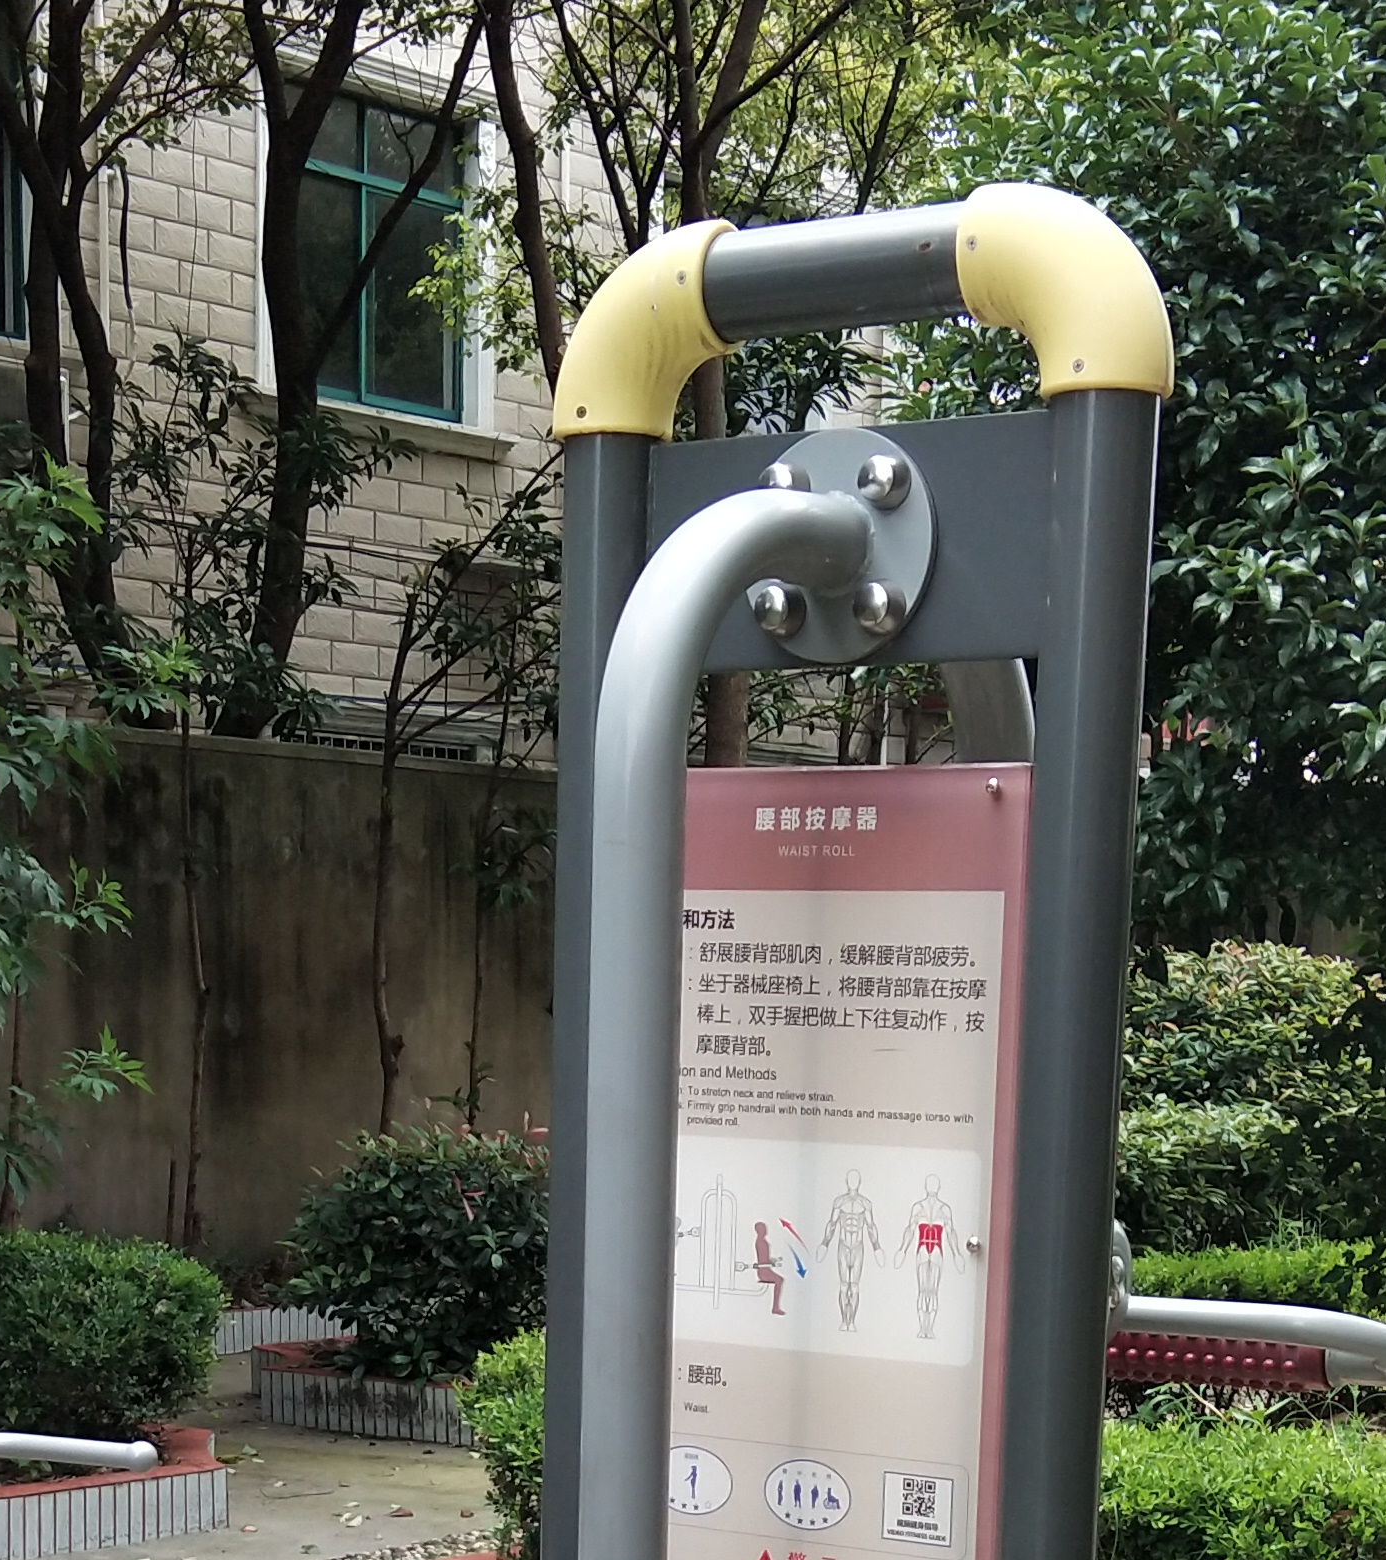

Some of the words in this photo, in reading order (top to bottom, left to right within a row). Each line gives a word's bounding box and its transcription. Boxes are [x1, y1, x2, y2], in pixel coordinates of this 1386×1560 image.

[754, 805, 879, 831] 腰部按摩器
[778, 844, 817, 857] WAIST
[822, 845, 856, 858] ROLL
[700, 1066, 722, 1079] and
[725, 1066, 777, 1080] Methods
[688, 1085, 699, 1095] To
[702, 1087, 731, 1097] stretch
[733, 1088, 754, 1098] neck
[756, 1089, 773, 1099] and
[776, 1090, 805, 1100] relieve
[688, 1100, 715, 1113] Firmly
[718, 1102, 735, 1113] grip
[738, 1102, 775, 1114] handrail
[778, 1105, 797, 1115] with
[800, 1106, 821, 1116] both
[824, 1107, 853, 1117] hands
[856, 1108, 874, 1119] and
[877, 1110, 922, 1123] massage
[925, 1112, 950, 1122] torso
[953, 1113, 974, 1124] with
